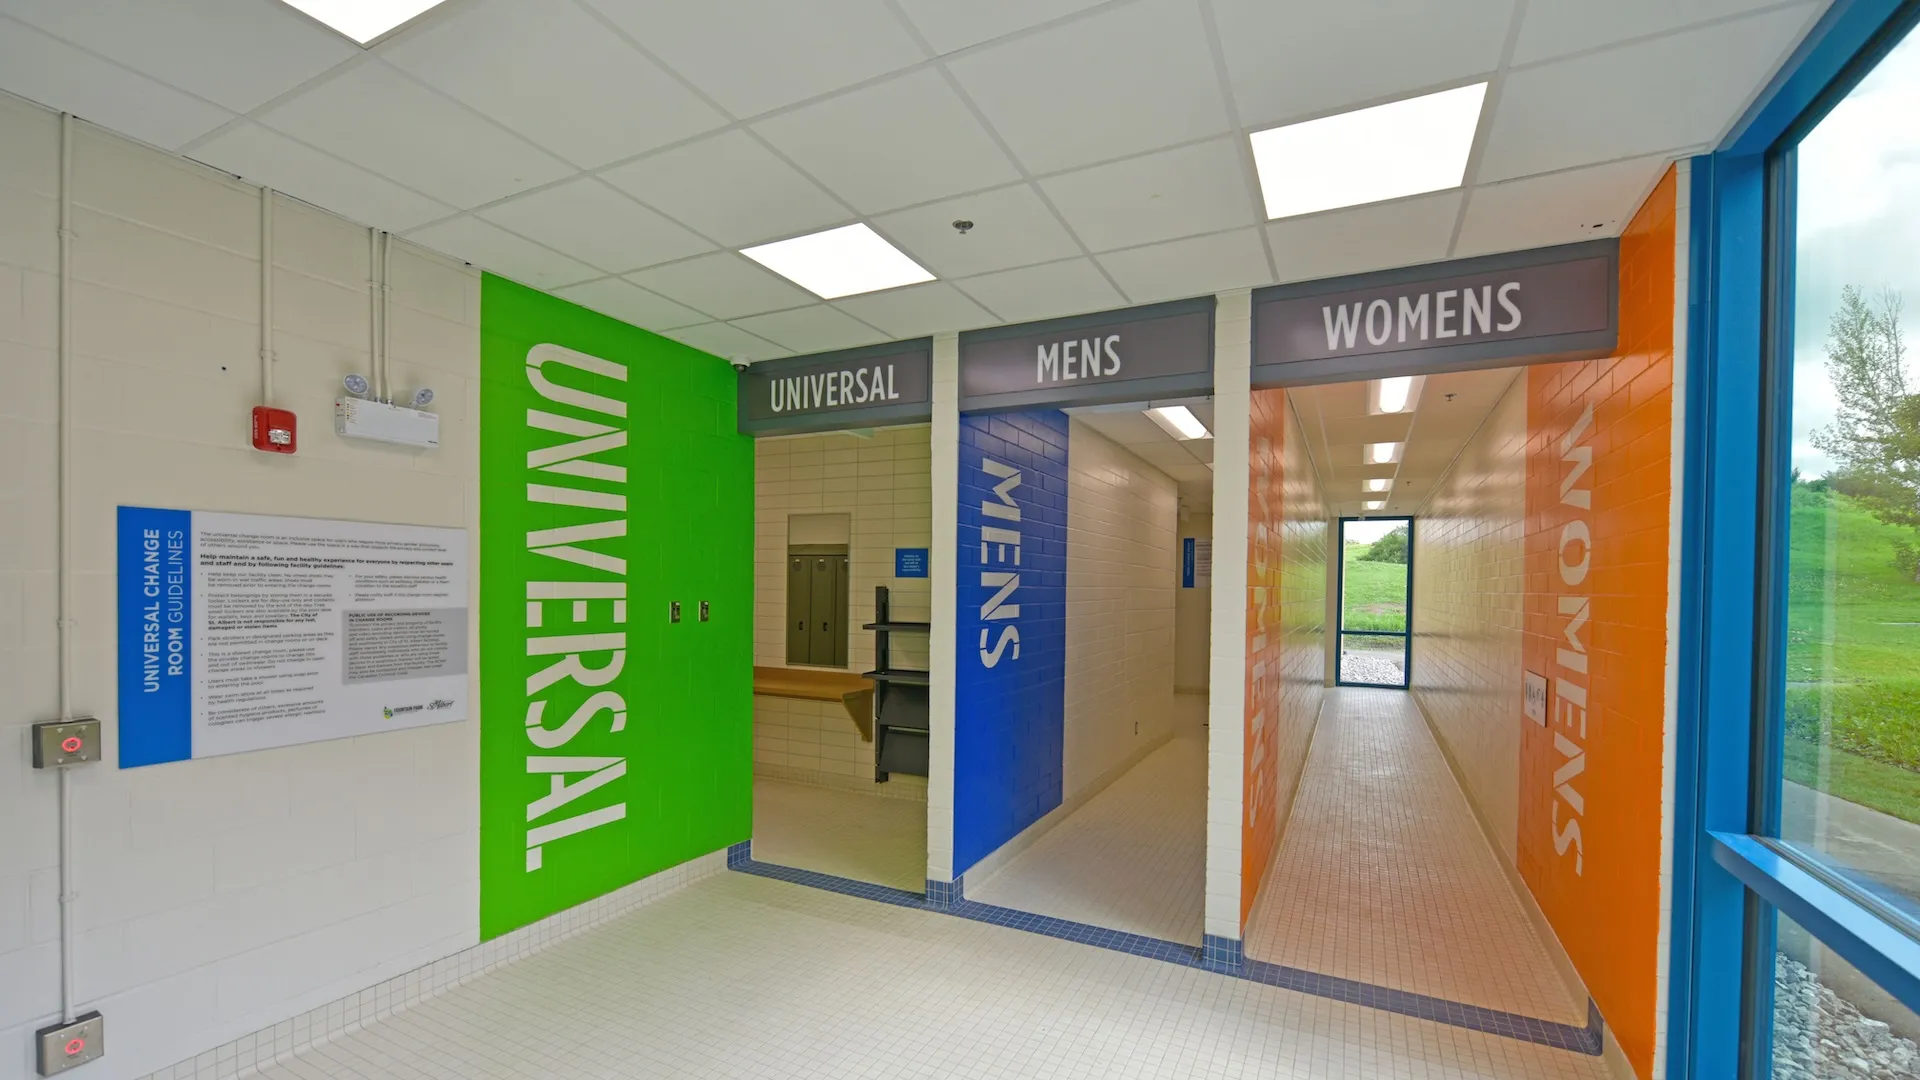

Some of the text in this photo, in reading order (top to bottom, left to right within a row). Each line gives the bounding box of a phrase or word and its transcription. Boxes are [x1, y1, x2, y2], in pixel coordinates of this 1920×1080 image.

[1037, 334, 1121, 384] MENS
[1323, 282, 1522, 351] WOMENS
[771, 364, 899, 412] UNIVERSAL
[143, 529, 160, 693] UNIVERSAL CHANGE
[168, 530, 183, 676] ROOM GUIDELINES
[200, 553, 218, 561] Help
[299, 556, 322, 564] healthy
[258, 561, 289, 569] following
[290, 562, 312, 570] facility
[525, 343, 628, 872] UNIVERSAL
[980, 457, 1022, 669] MENS
[1551, 401, 1593, 877] WOMENS
